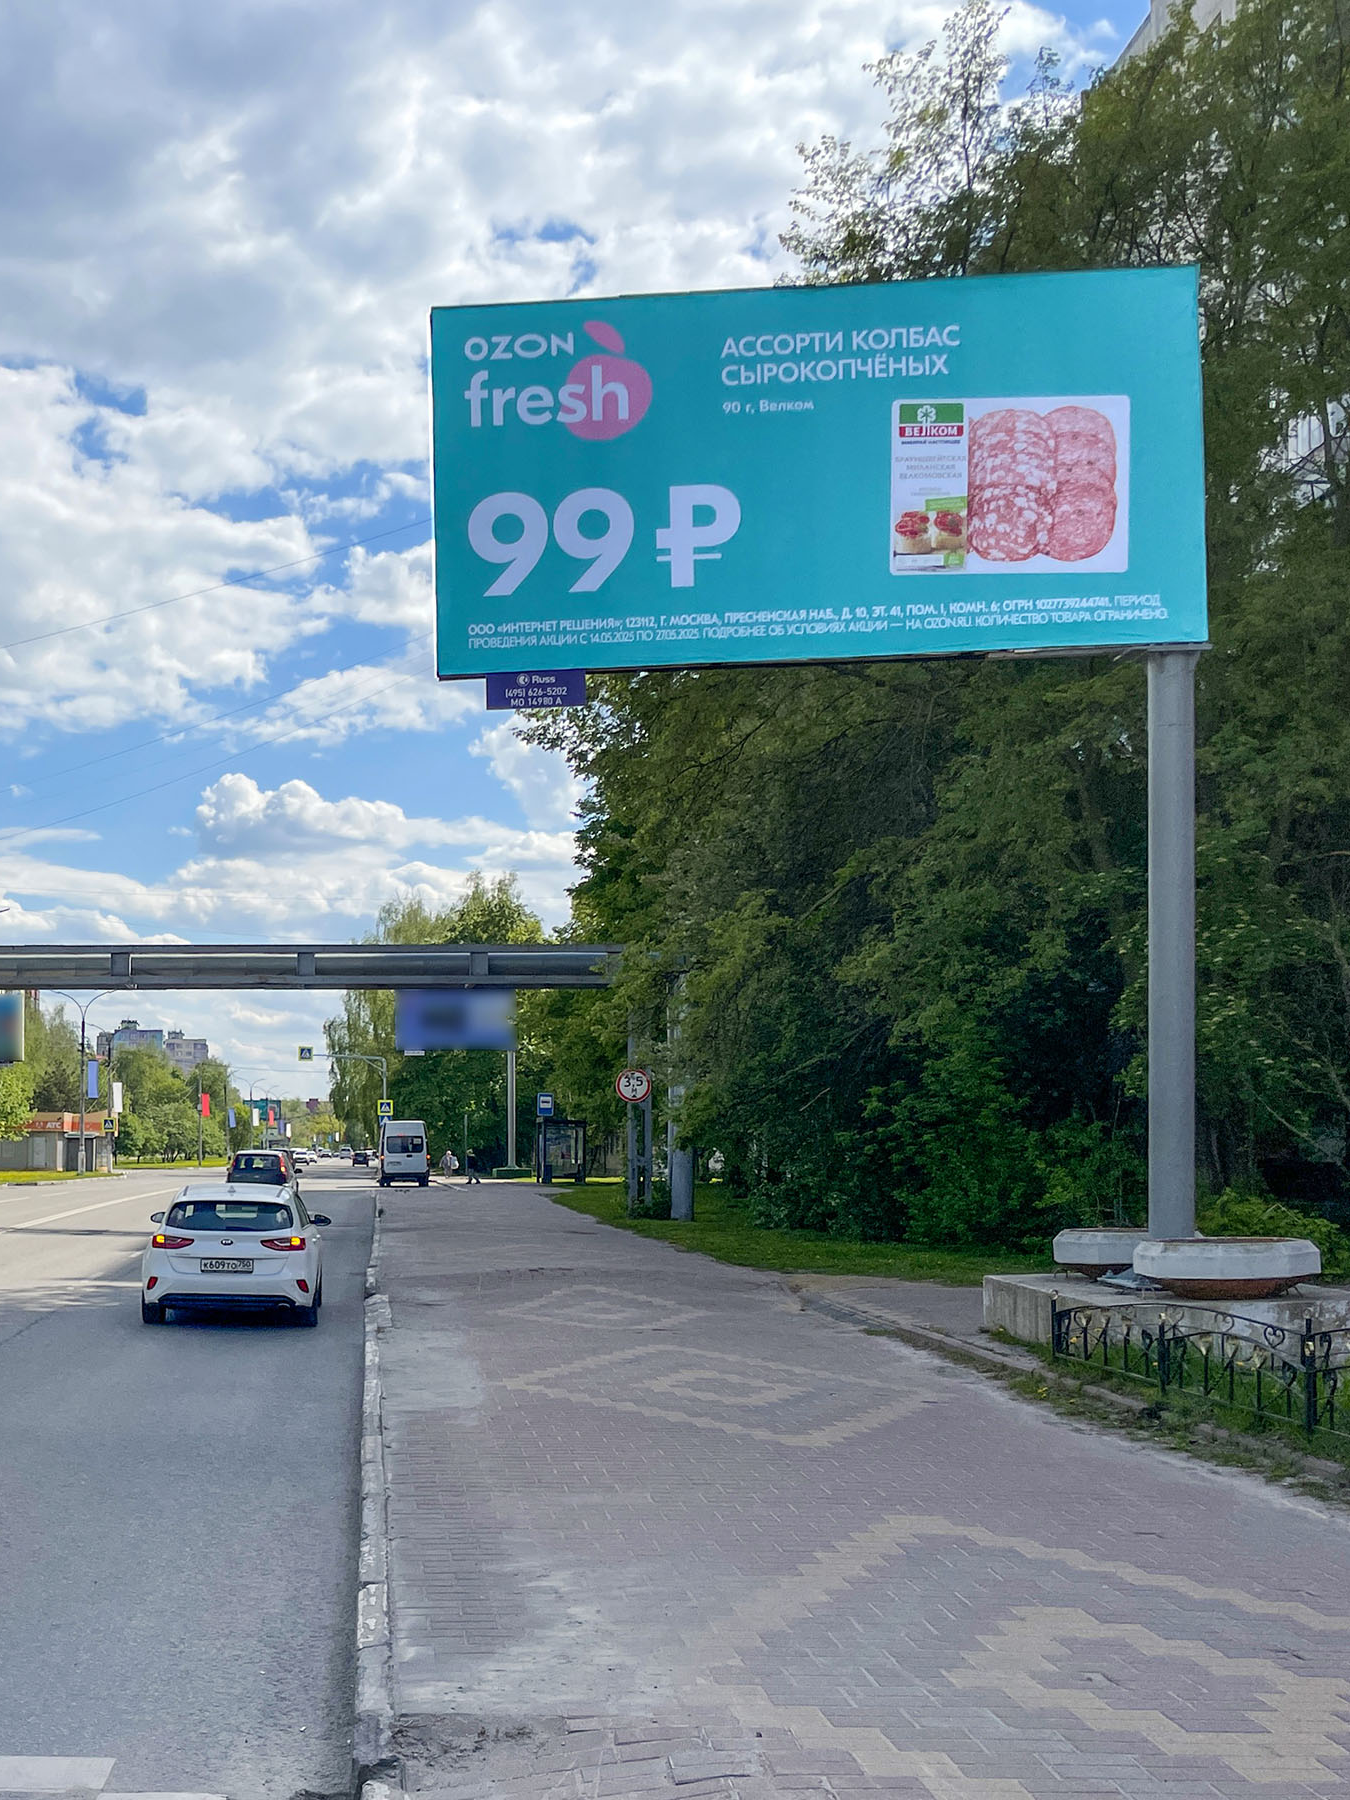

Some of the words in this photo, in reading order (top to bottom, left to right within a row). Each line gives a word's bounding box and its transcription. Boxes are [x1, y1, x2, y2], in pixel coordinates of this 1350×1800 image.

[464, 331, 574, 361] OZON
[720, 332, 843, 359] АССОРТИ
[852, 325, 960, 351] КОЛБАС
[721, 354, 949, 386] СЫРОКОПЧЁНЫХ
[464, 365, 629, 427] fresh
[722, 402, 741, 414] 90
[745, 403, 755, 414] г,
[759, 400, 815, 412] Велком
[905, 425, 958, 437] ВЕЛКОМ
[467, 487, 635, 597] 99
[468, 624, 495, 635] ООО
[497, 620, 556, 634] «ИНТЕРНЕТ
[660, 616, 667, 626] Г.
[669, 613, 722, 626] МОСКВА,
[724, 609, 807, 624] ПРЕСНЕНСКАЯ
[841, 608, 853, 620] Д.
[855, 607, 869, 620] 10,
[872, 605, 888, 617] ЭТ.
[890, 605, 903, 618] 41,
[906, 604, 937, 616] ПОМ.
[949, 600, 988, 613] КОМН.
[990, 602, 1000, 613] 6;
[1003, 599, 1033, 611] ОГРН
[1114, 594, 1161, 607] ПЕРИОД
[468, 635, 537, 649] ПРОВЕДЕНИЯ
[539, 633, 578, 647] АКЦИИ
[580, 633, 588, 644] С
[636, 629, 653, 642] ПО
[703, 626, 766, 639] ПОДРОБНЕЕ
[768, 625, 784, 637] ОБ
[786, 621, 847, 636] УСЛОВИЯХ
[848, 620, 888, 633] АКЦИИ
[906, 618, 922, 630] НА
[975, 613, 1048, 626] КОЛИЧЕСТВО
[1050, 611, 1091, 623] ТОВАРА
[505, 688, 526, 698] (495)
[528, 687, 568, 696] 626-5202
[531, 675, 556, 684] Russ
